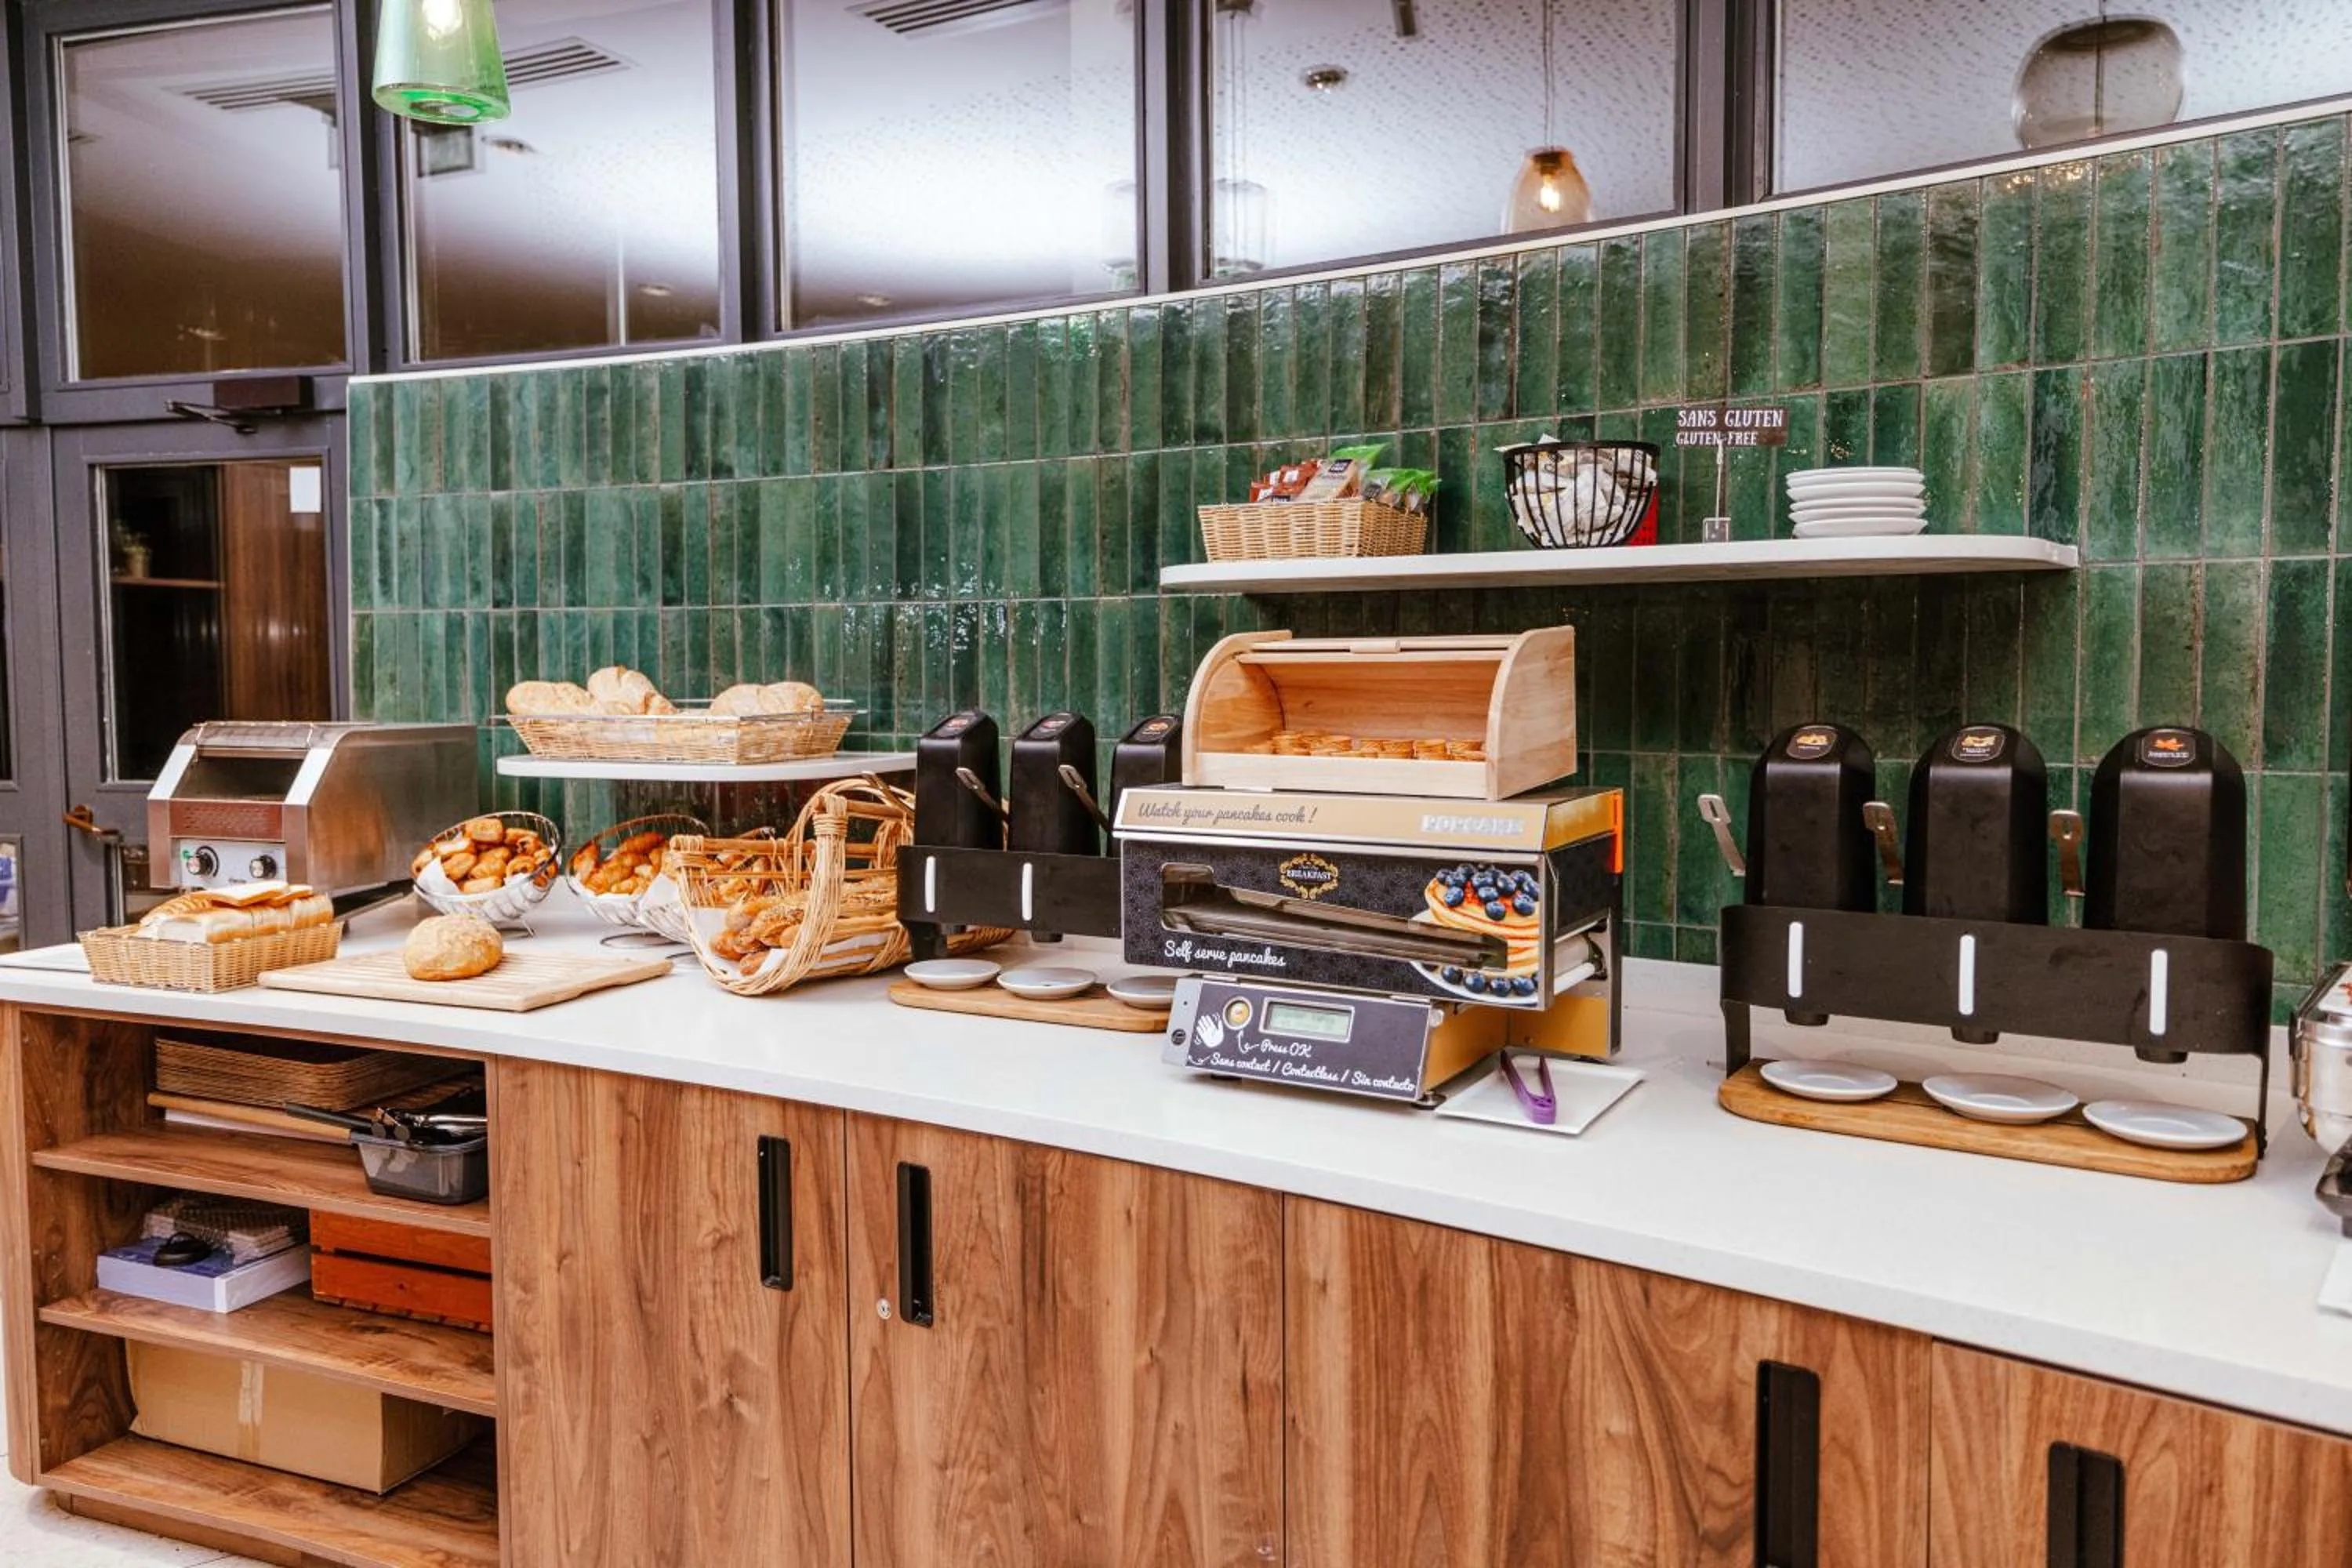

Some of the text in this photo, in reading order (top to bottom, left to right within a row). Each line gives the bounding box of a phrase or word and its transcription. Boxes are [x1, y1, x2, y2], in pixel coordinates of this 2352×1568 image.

[1678, 409, 1784, 427] SANS GLUTEN
[1675, 431, 1758, 446] GLUTEN FREE
[1138, 801, 1181, 818] Watch
[1182, 808, 1213, 825] your
[1213, 804, 1272, 826] pancakes
[1276, 806, 1306, 823] cook
[1164, 940, 1287, 968] Self serve pancakes
[1260, 1039, 1312, 1058] Press OK
[1210, 1052, 1235, 1066] Sans
[1236, 1058, 1271, 1072] contact
[1281, 1061, 1339, 1082] Contactless
[1351, 1070, 1371, 1086] Sin
[1373, 1075, 1416, 1091] contacto
